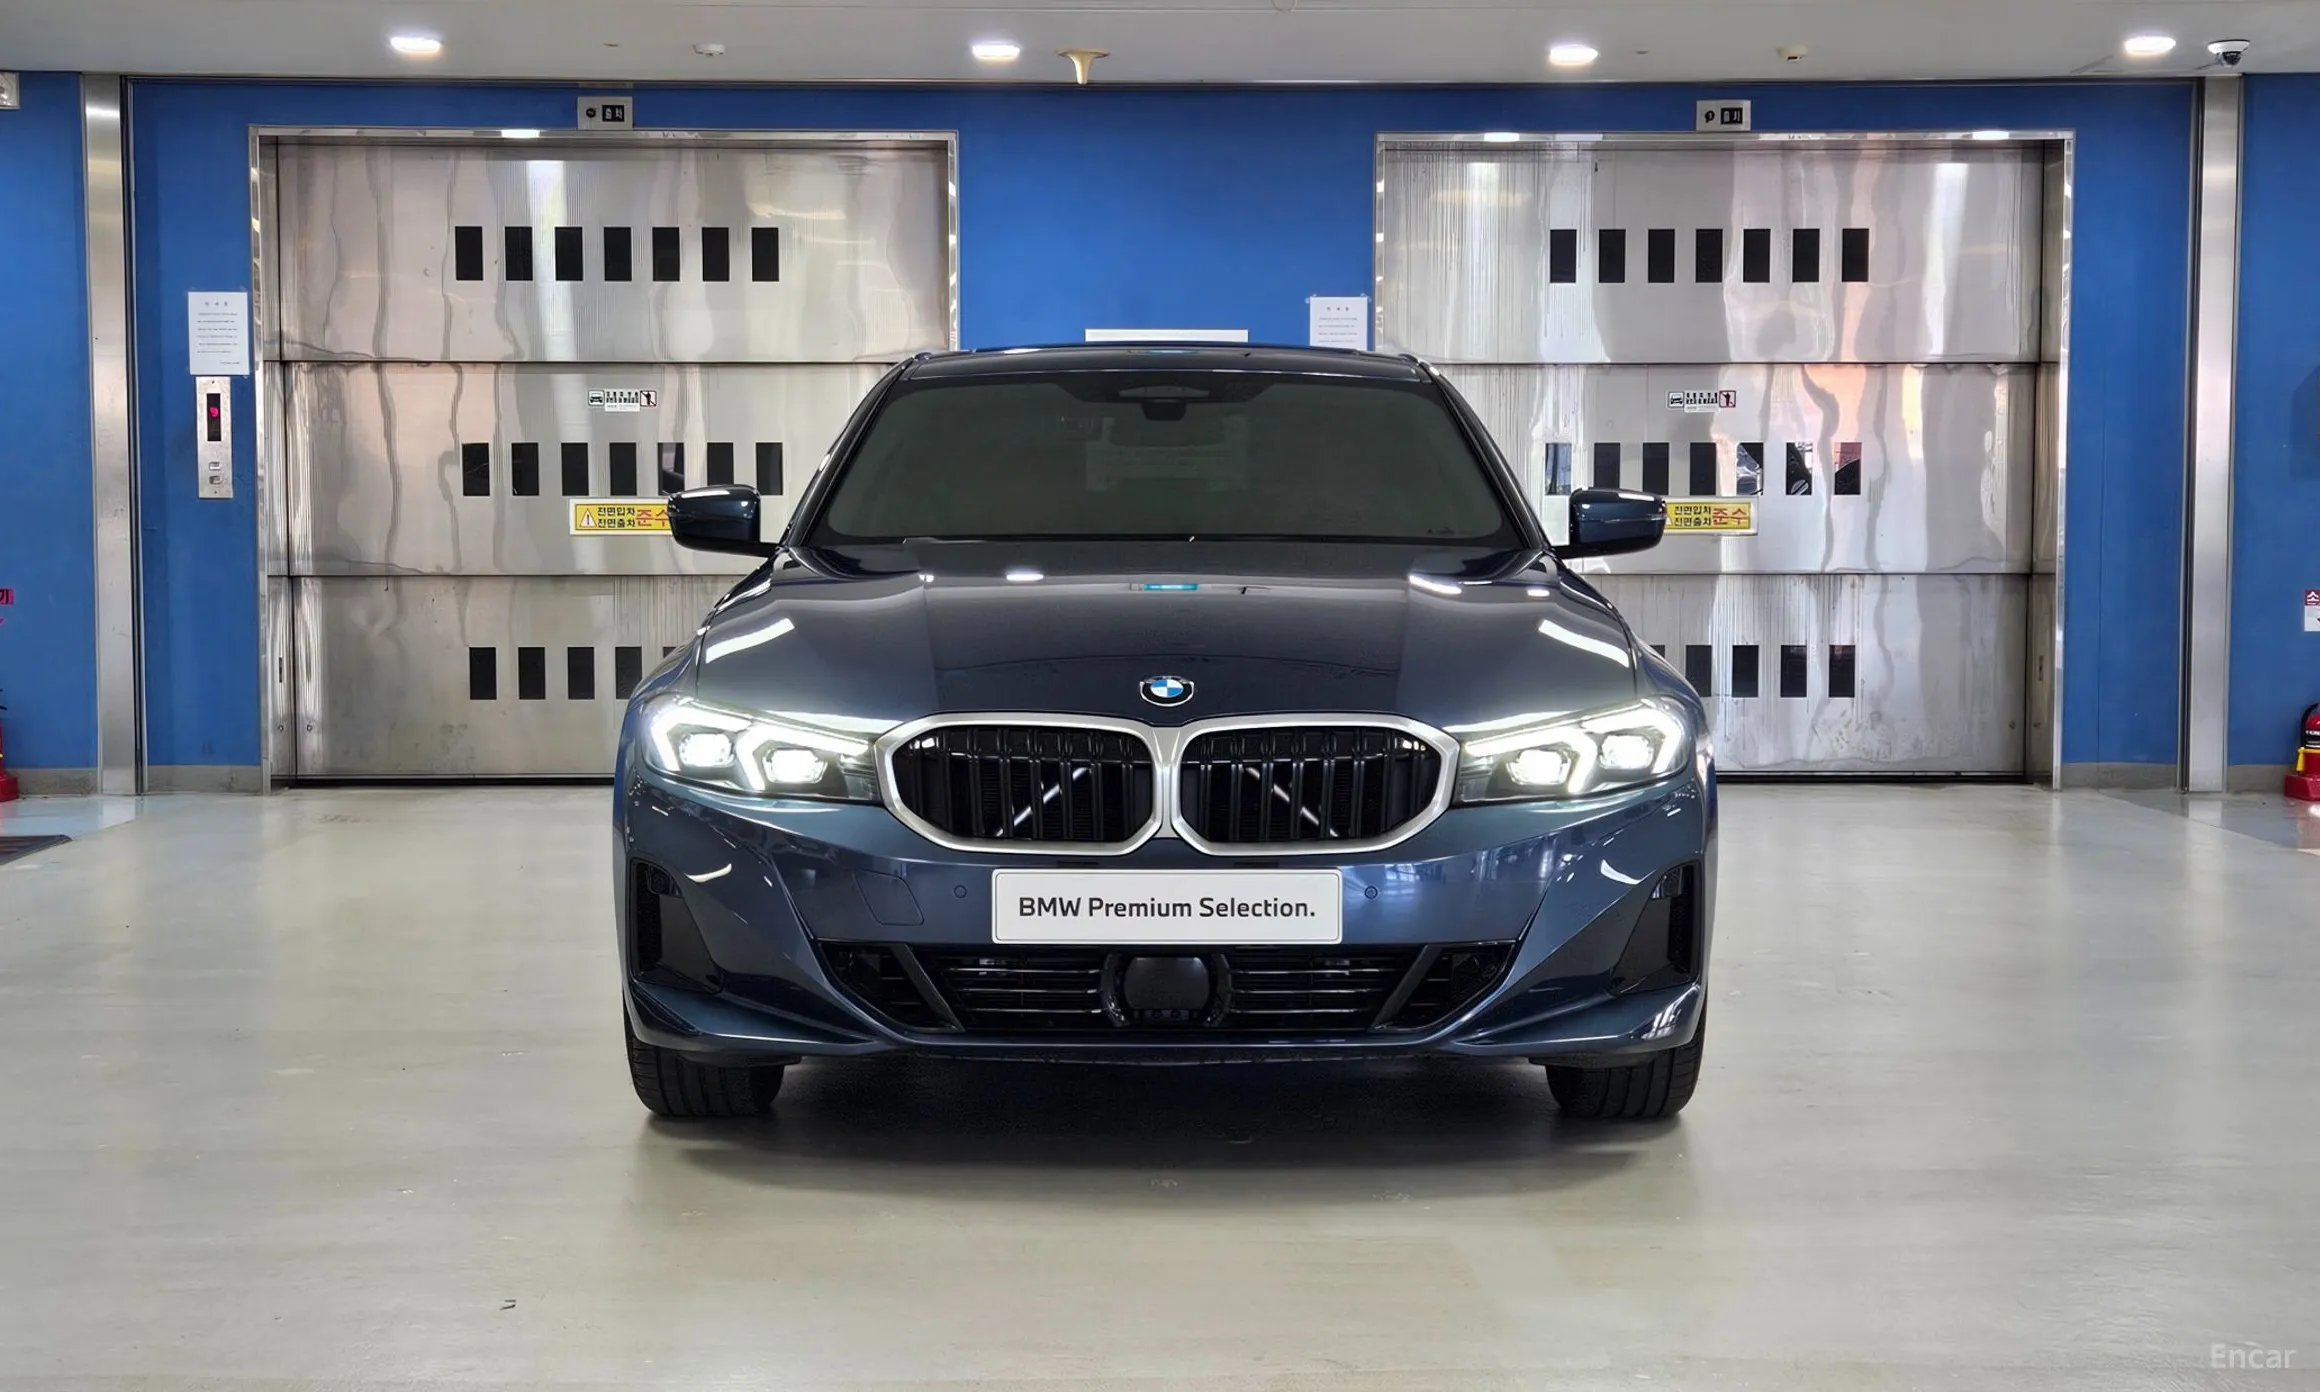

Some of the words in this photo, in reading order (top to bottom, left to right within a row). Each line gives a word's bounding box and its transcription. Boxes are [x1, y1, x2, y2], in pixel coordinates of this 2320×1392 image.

[597, 507, 636, 517] 전면입차
[1674, 506, 1711, 516] 전면입차
[1712, 508, 1751, 526] 준수
[597, 518, 636, 528] 전면출차
[1019, 897, 1081, 917] BMW
[1088, 897, 1192, 917] Premium
[1199, 897, 1316, 917] Selection.
